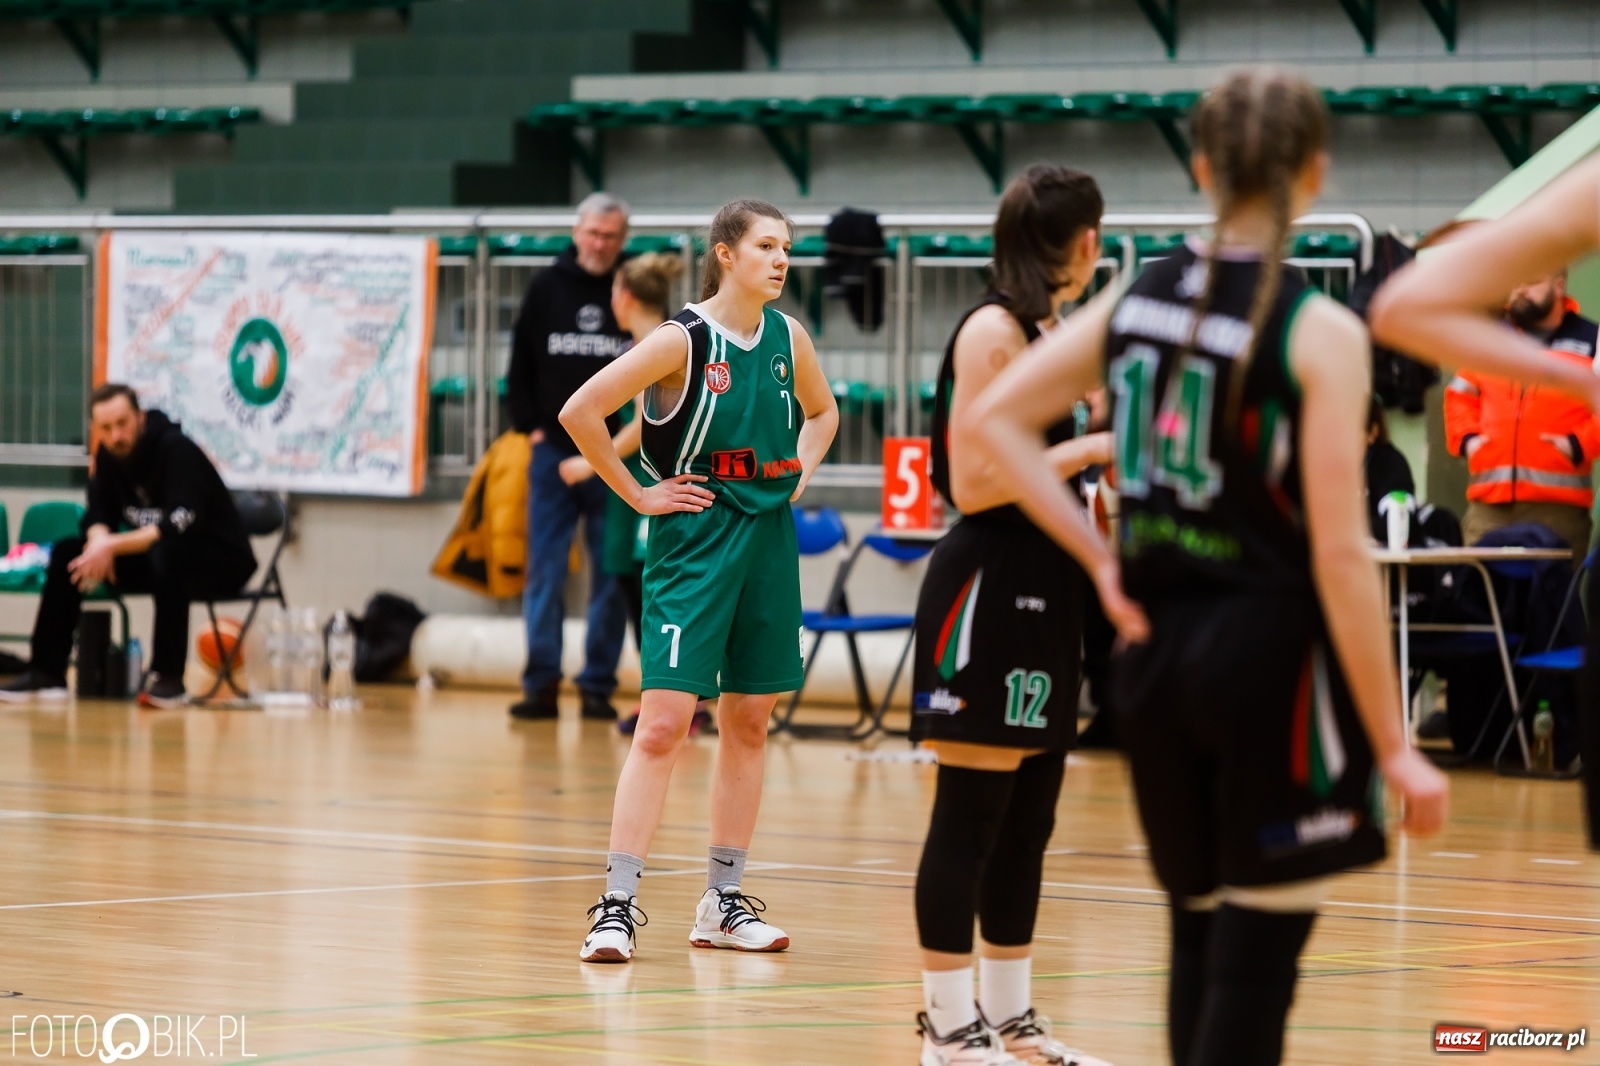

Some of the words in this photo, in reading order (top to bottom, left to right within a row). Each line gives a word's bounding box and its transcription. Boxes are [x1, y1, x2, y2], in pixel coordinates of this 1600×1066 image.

[780, 390, 792, 430] 7
[1109, 343, 1224, 512] 14
[888, 446, 923, 510] 5
[660, 623, 682, 668] 7
[1004, 667, 1053, 729] 12
